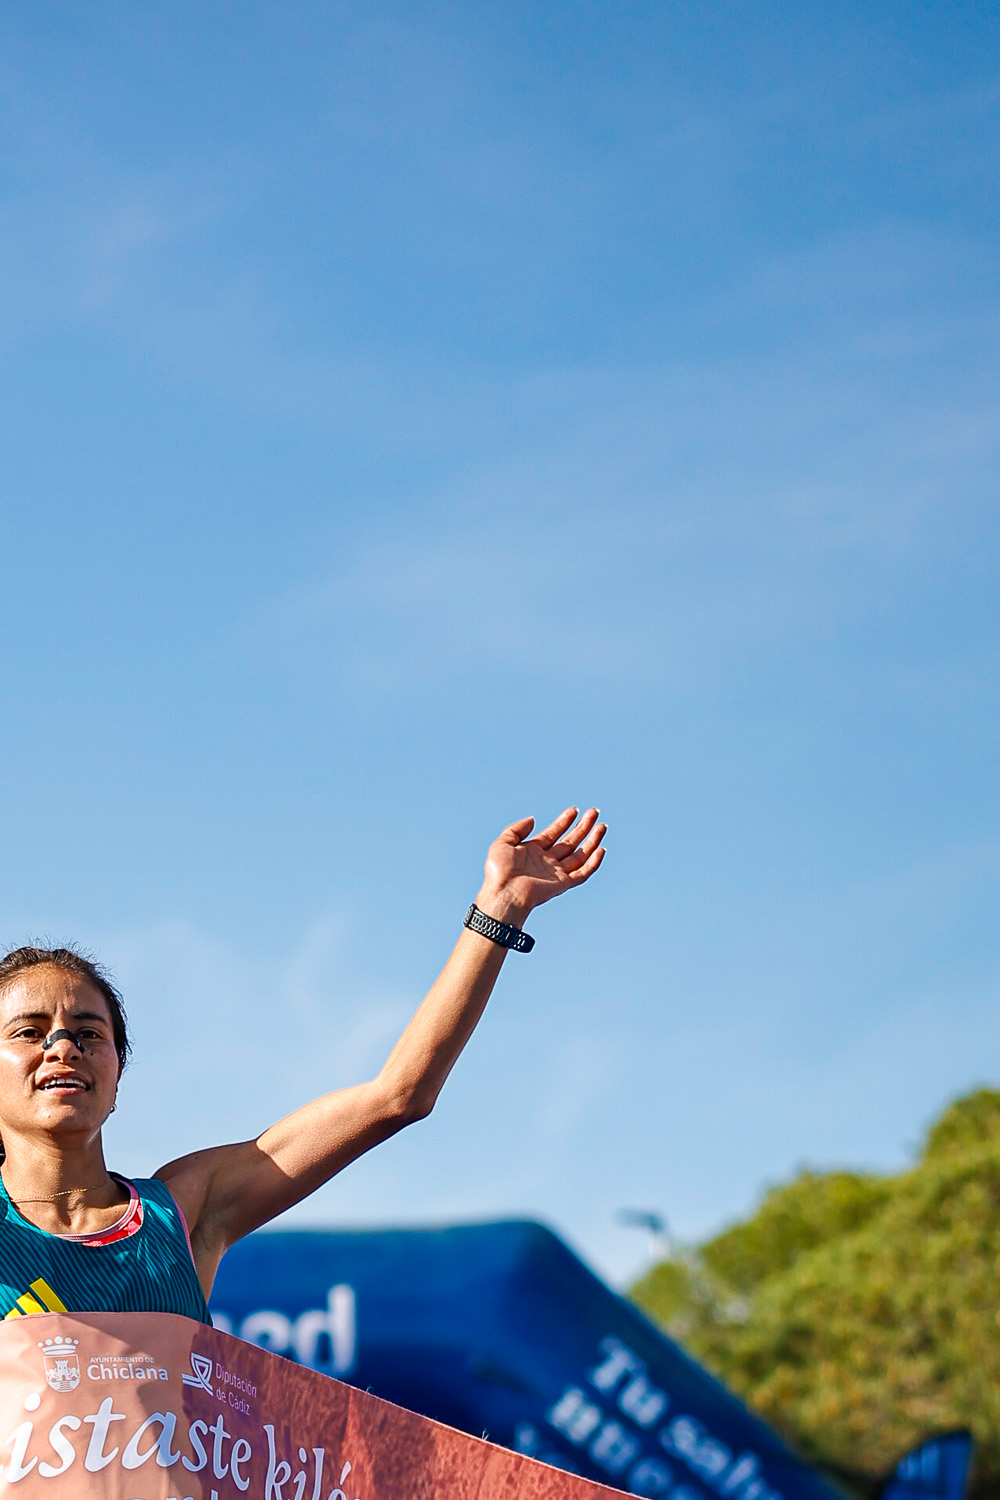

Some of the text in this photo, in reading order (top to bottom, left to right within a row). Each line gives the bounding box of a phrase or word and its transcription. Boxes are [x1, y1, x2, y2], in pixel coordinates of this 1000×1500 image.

[90, 1356, 143, 1364] AYUNTAMIENTO
[87, 1363, 169, 1381] Chiclana
[215, 1363, 257, 1399] Diputación
[216, 1387, 251, 1416] de Cádiz
